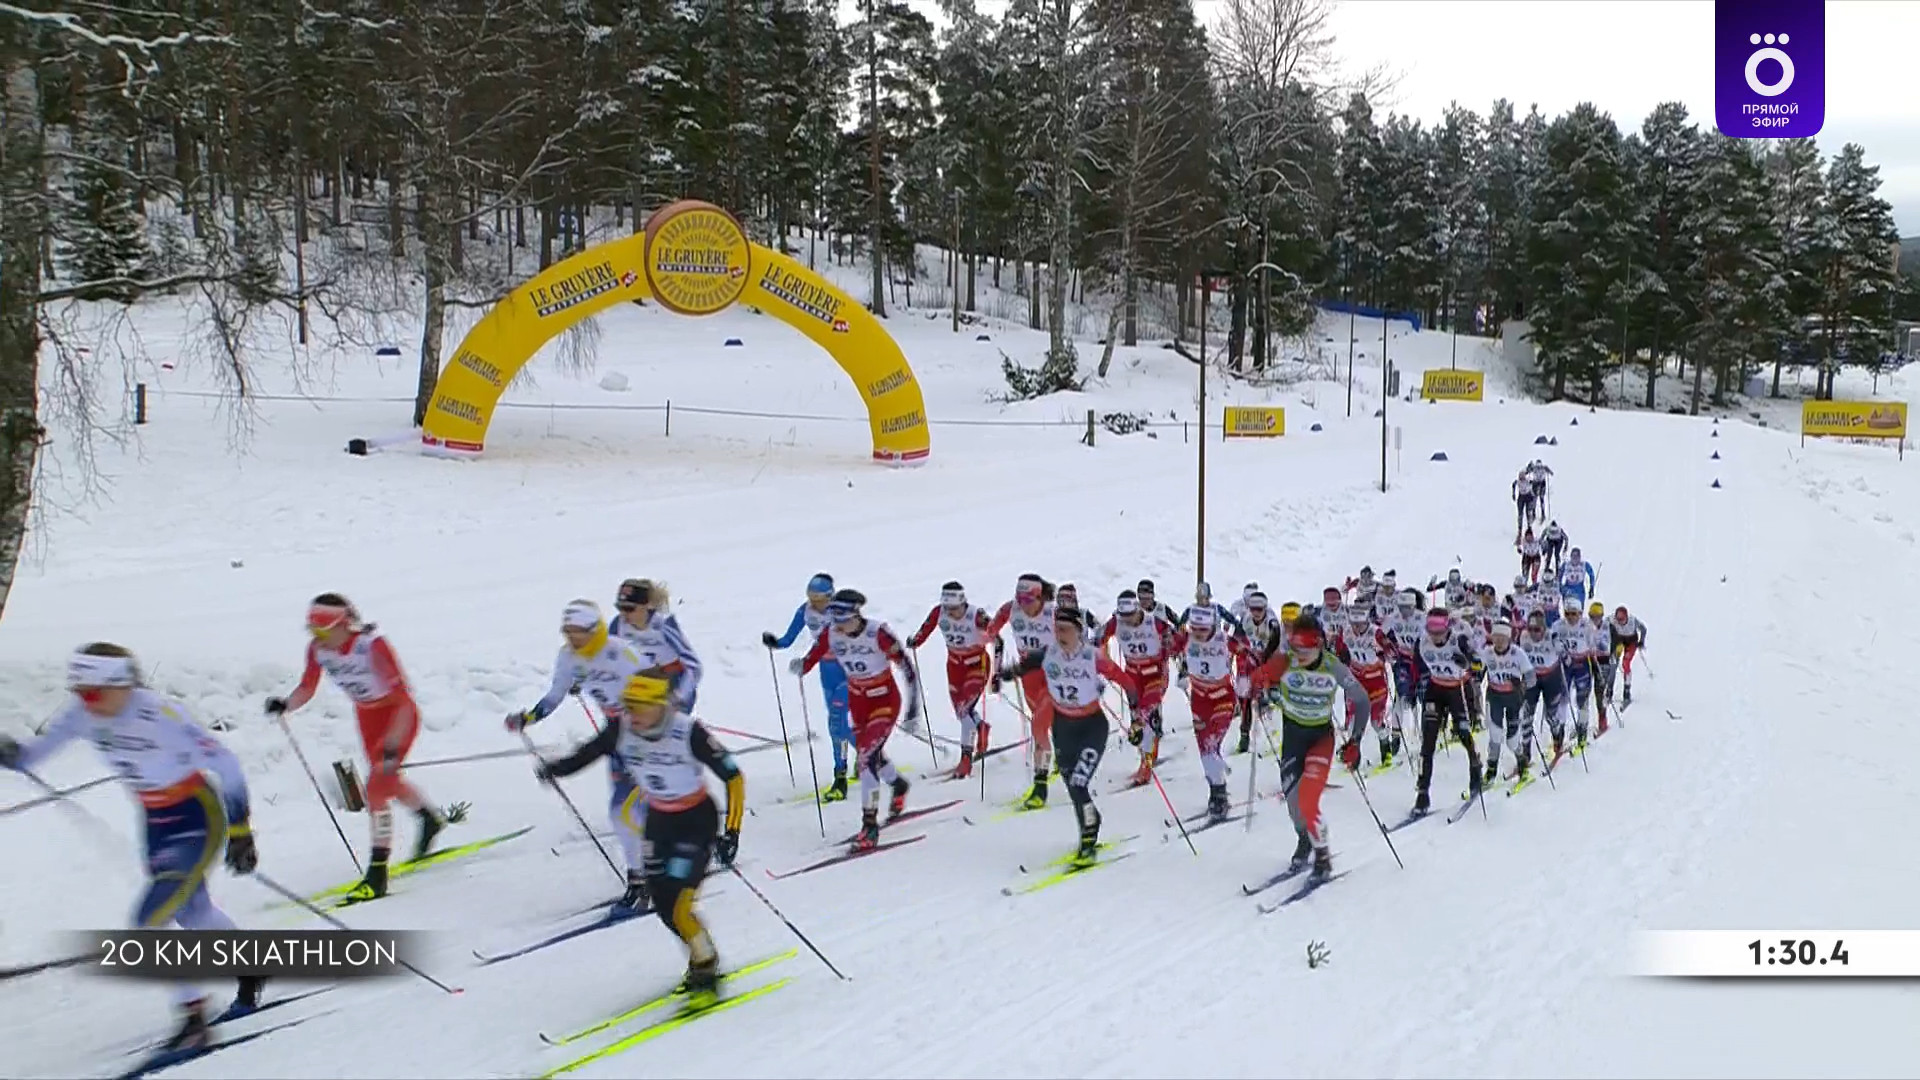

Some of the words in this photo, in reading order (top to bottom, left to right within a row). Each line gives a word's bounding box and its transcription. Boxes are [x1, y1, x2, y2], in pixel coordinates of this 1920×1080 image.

[764, 262, 783, 284] LE
[529, 287, 551, 308] LE
[953, 625, 972, 635] SCA
[1028, 624, 1051, 633] SCA
[851, 644, 875, 655] SCA
[1203, 647, 1225, 657] SCA
[1063, 667, 1091, 679] SCA
[1200, 662, 1210, 675] 3
[1307, 676, 1334, 688] SCA
[1055, 684, 1079, 700] 12
